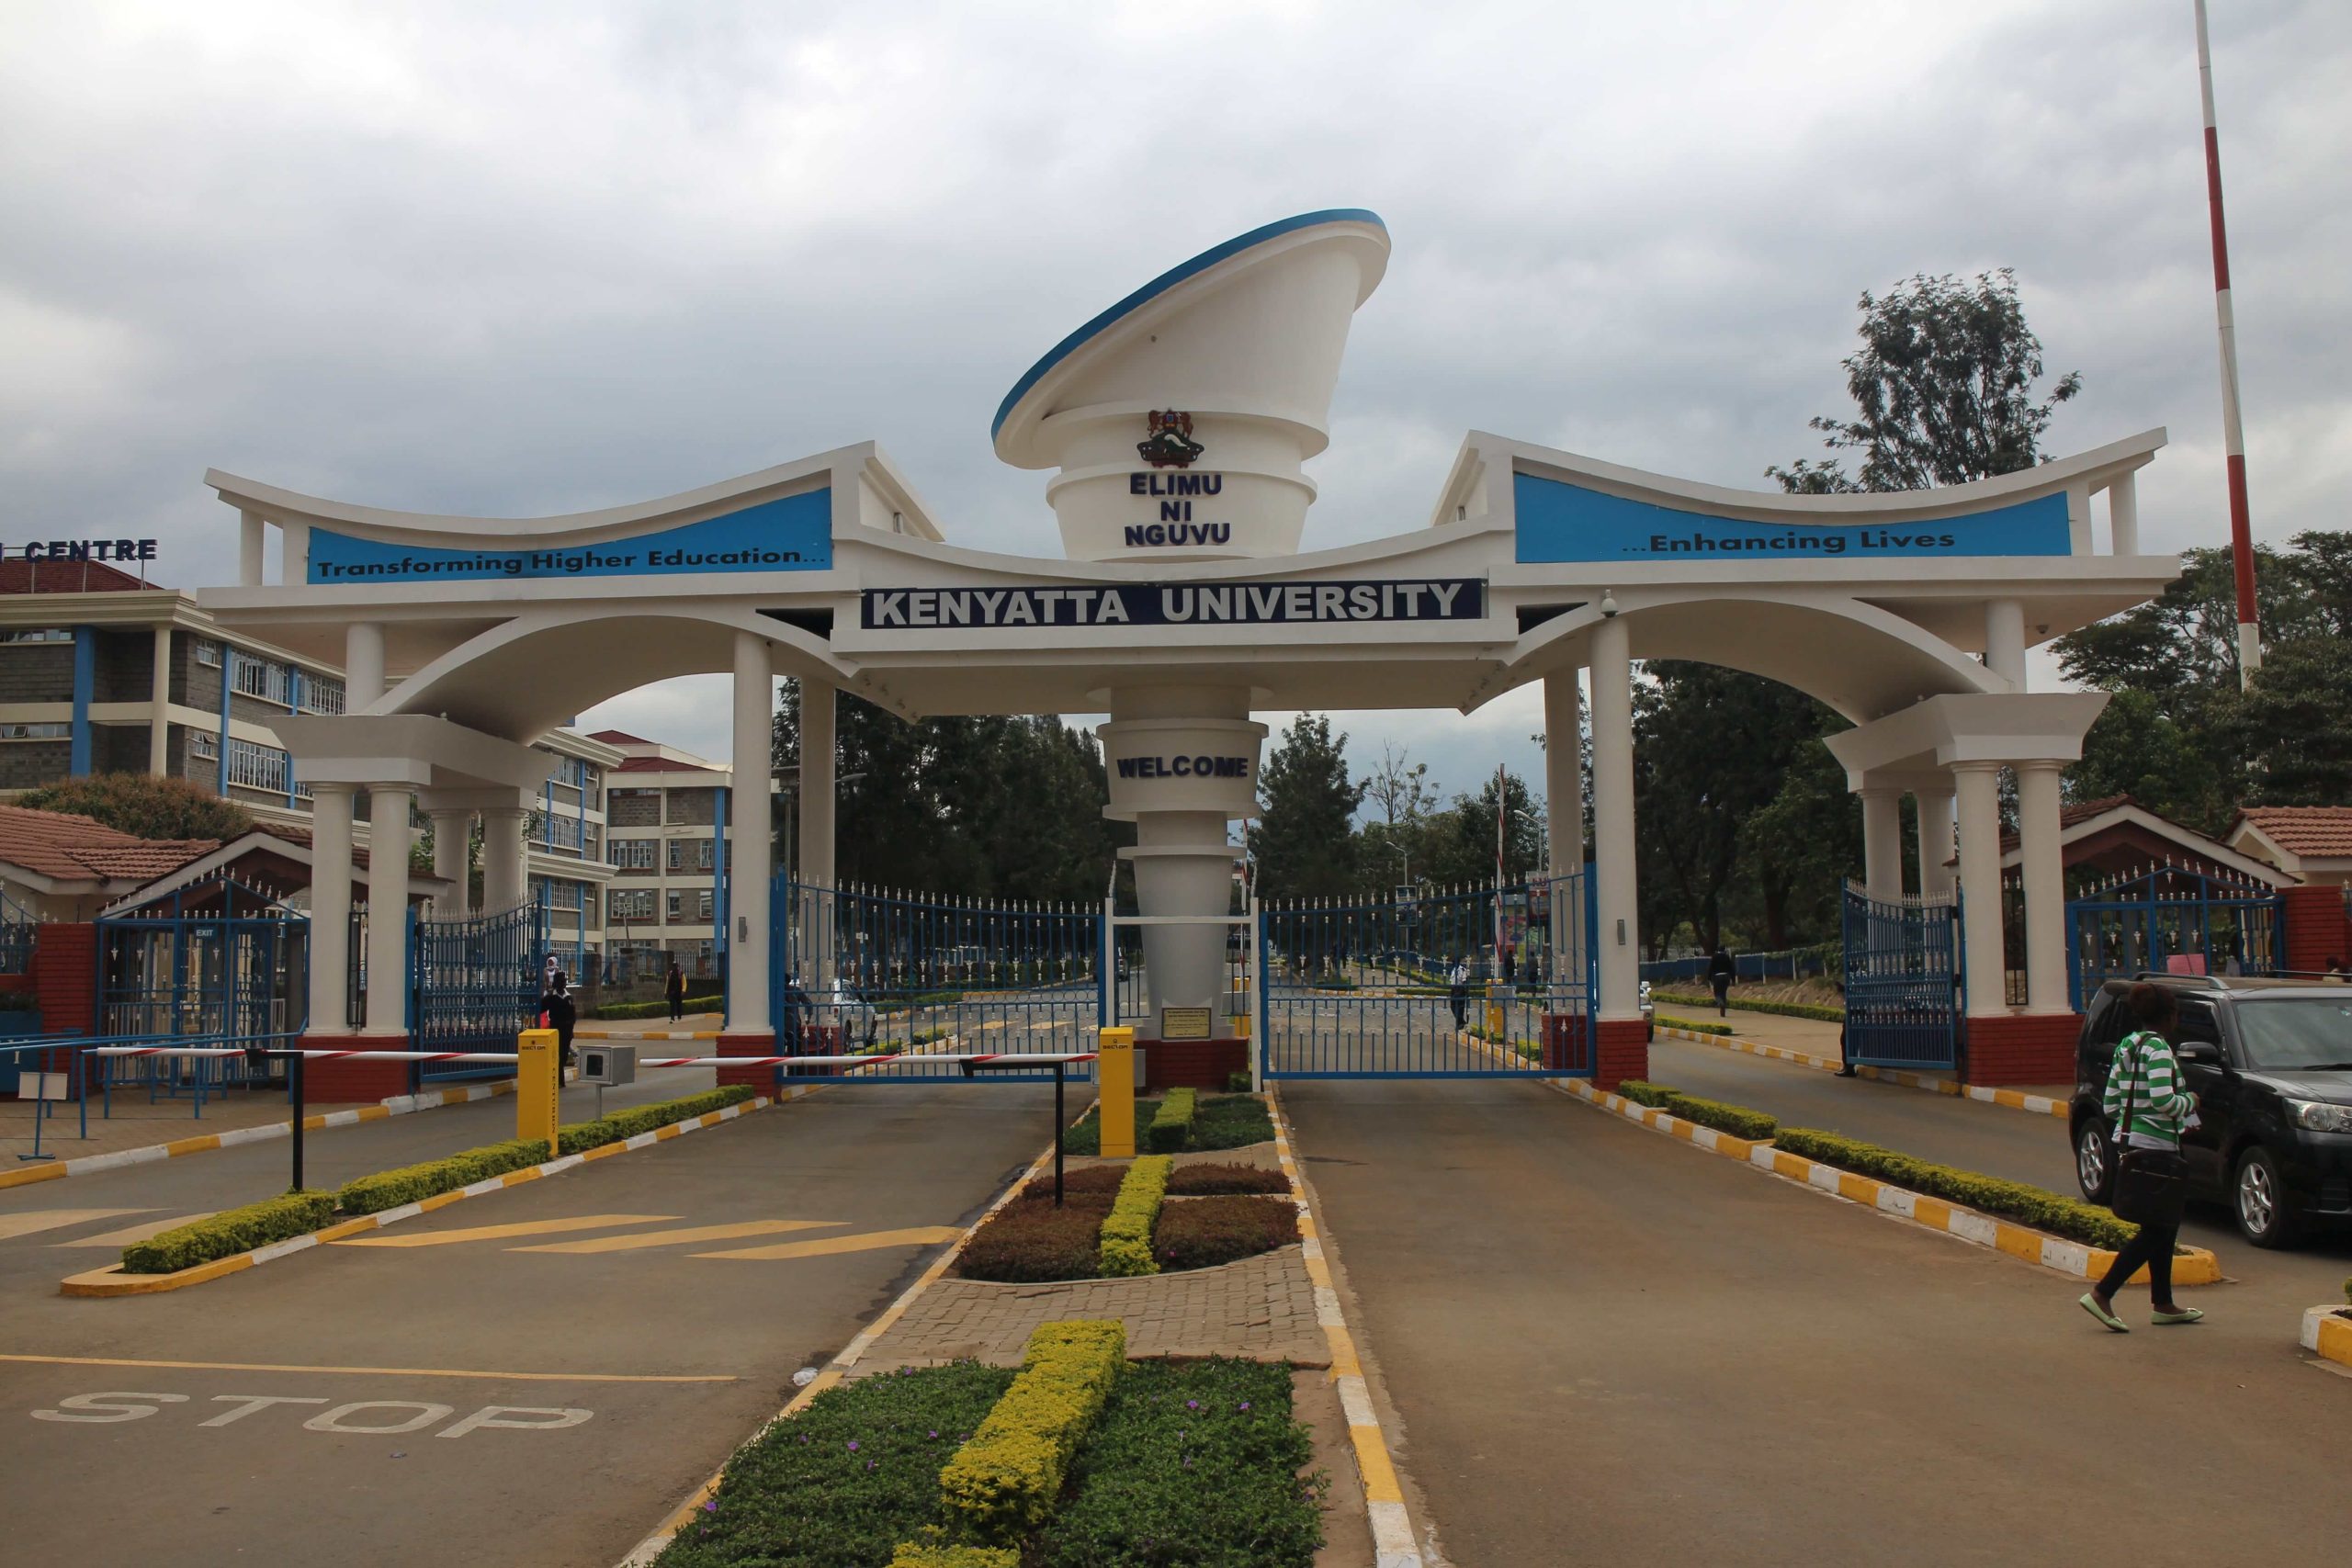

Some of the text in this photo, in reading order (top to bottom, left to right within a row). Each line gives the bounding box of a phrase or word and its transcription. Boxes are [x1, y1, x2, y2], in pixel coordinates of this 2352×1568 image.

[1130, 474, 1222, 496] ELIMU
[1160, 501, 1192, 522] NI
[1125, 523, 1230, 547] NGUVU
[1860, 530, 1956, 548] Lives
[25, 539, 158, 563] CENTRE
[317, 555, 523, 577] Transforming
[531, 551, 638, 573] Higher
[872, 583, 1464, 626] KENYATTA UNIVERSITY
[1116, 755, 1249, 779] WELCOME
[196, 929, 214, 937] EXIT
[30, 1392, 594, 1438] STOP
